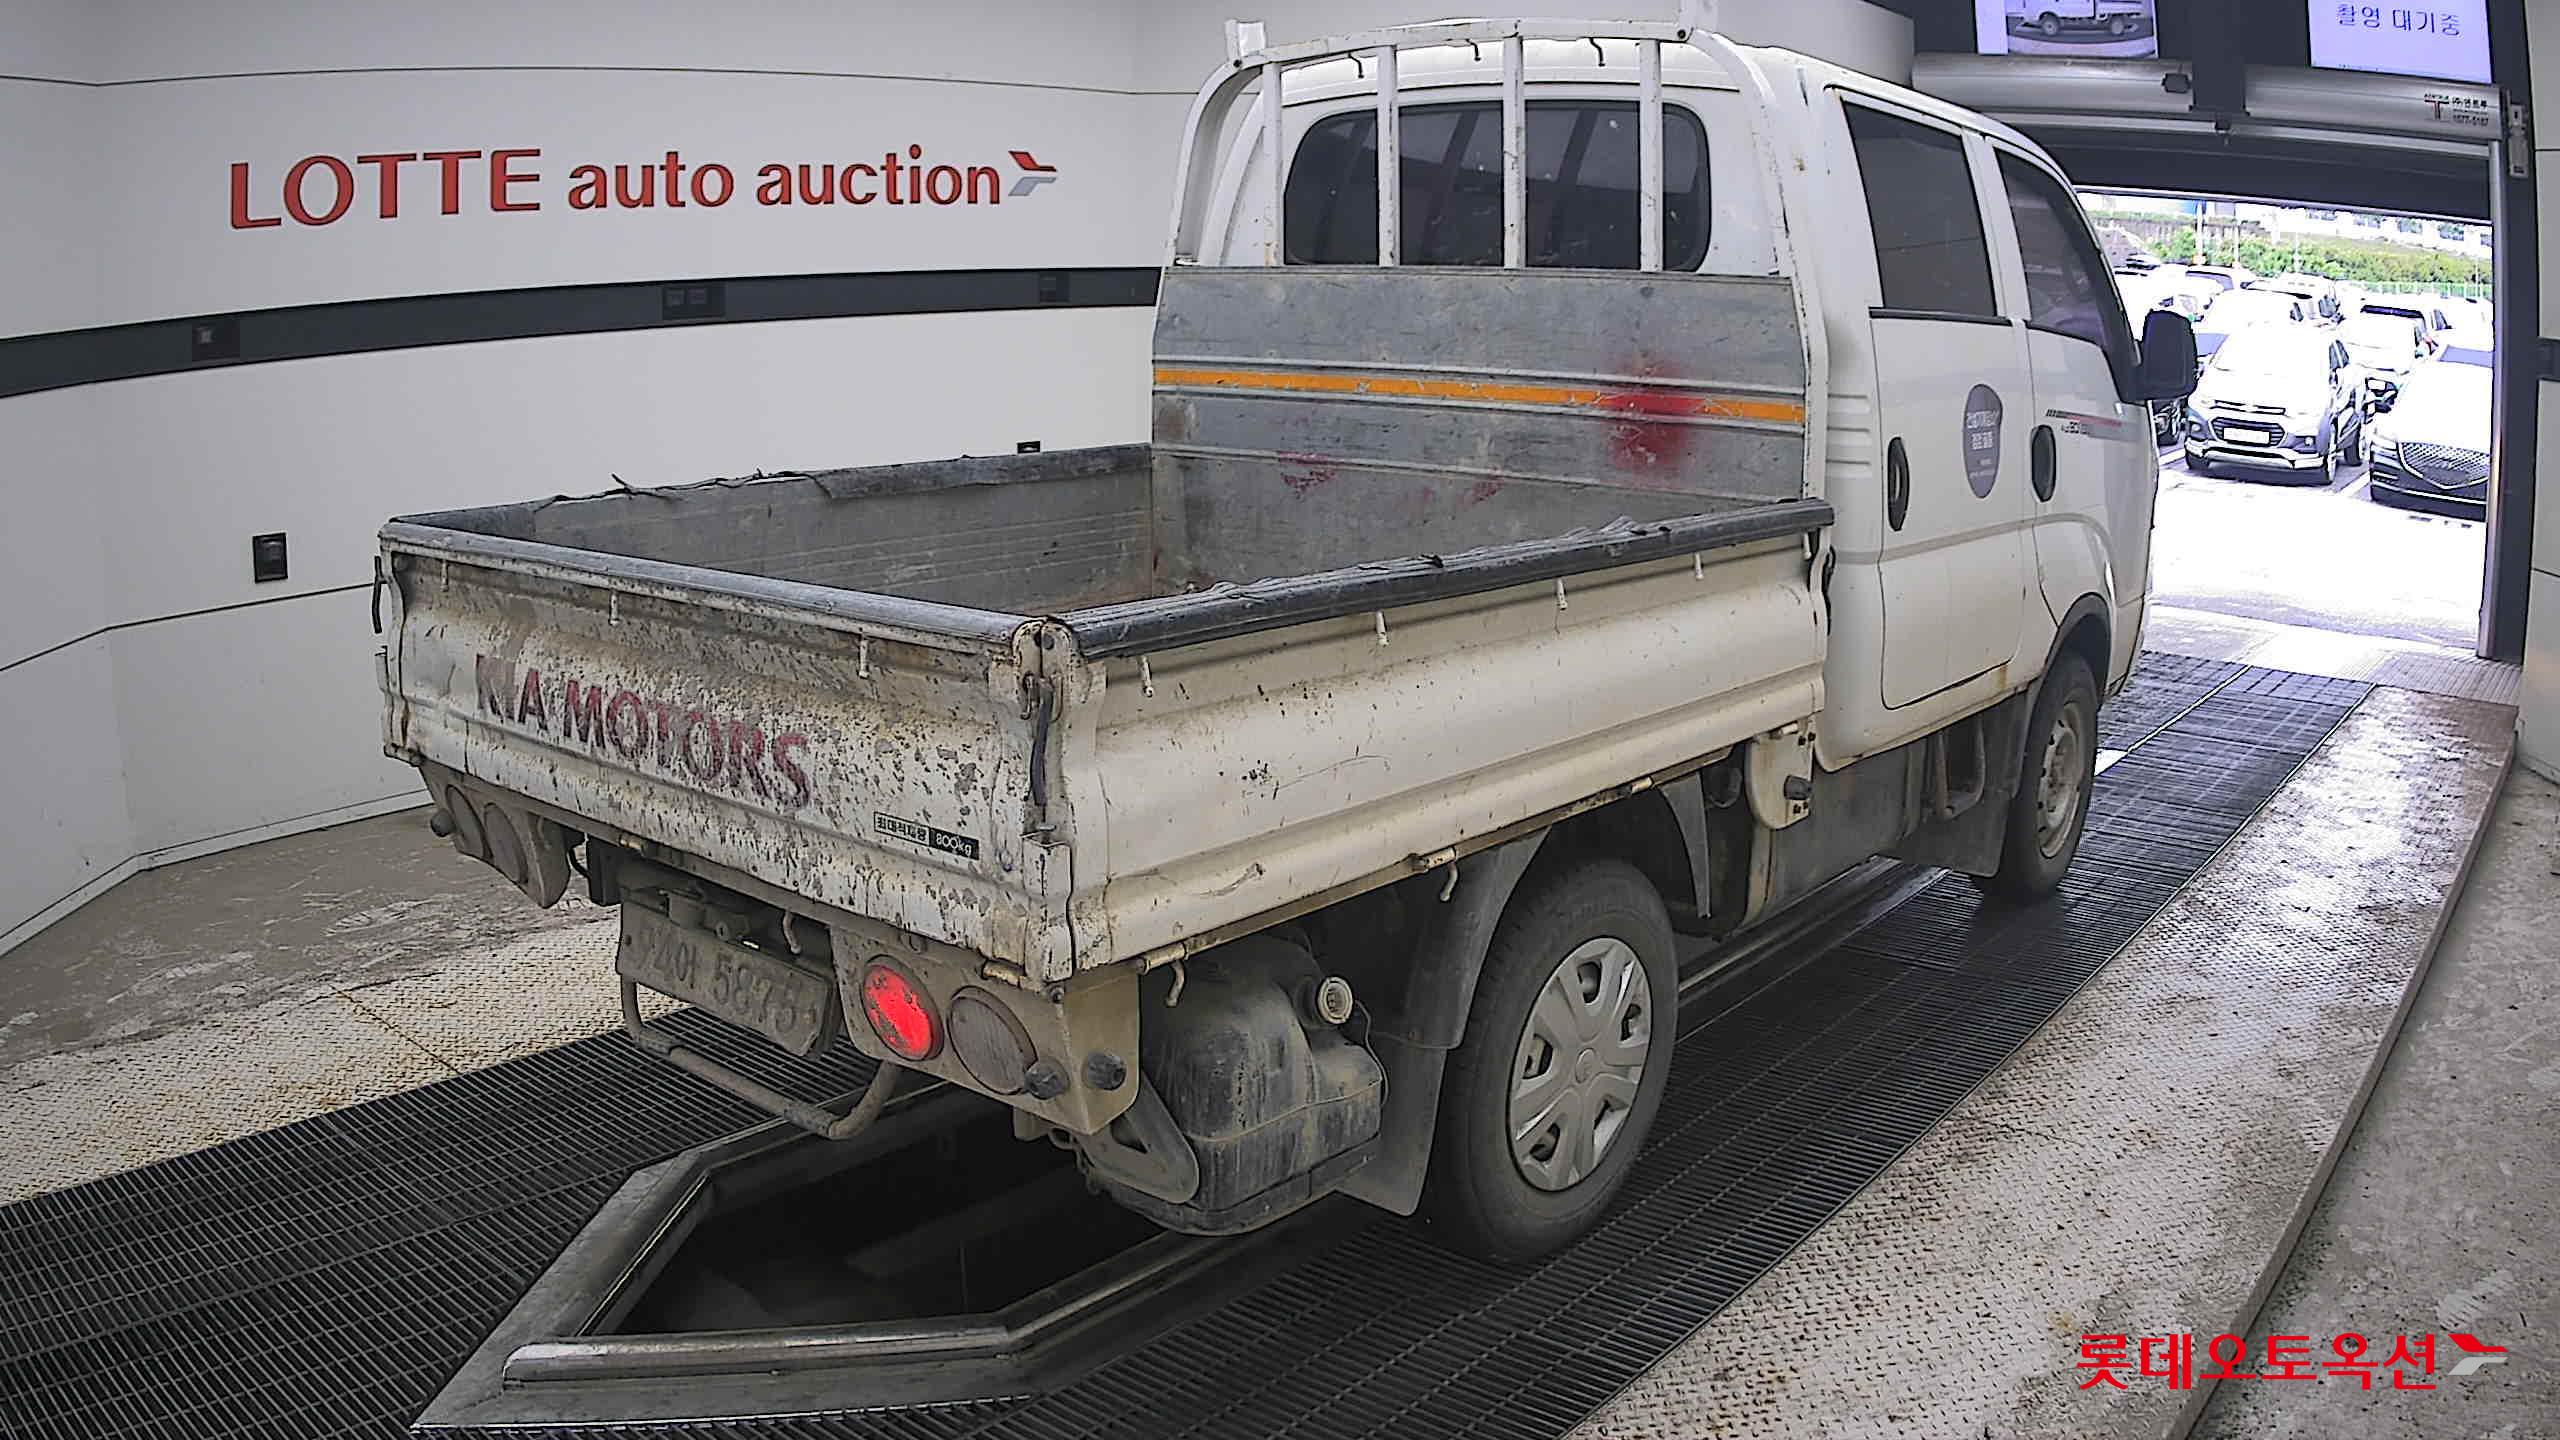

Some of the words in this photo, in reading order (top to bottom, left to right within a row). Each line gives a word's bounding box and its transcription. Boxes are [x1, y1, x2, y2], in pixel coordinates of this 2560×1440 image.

[2337, 3, 2381, 29] 촬영
[230, 148, 542, 230] LOTTE
[567, 150, 734, 209] auto
[755, 144, 1001, 207] auction
[562, 679, 810, 808] MOTORS
